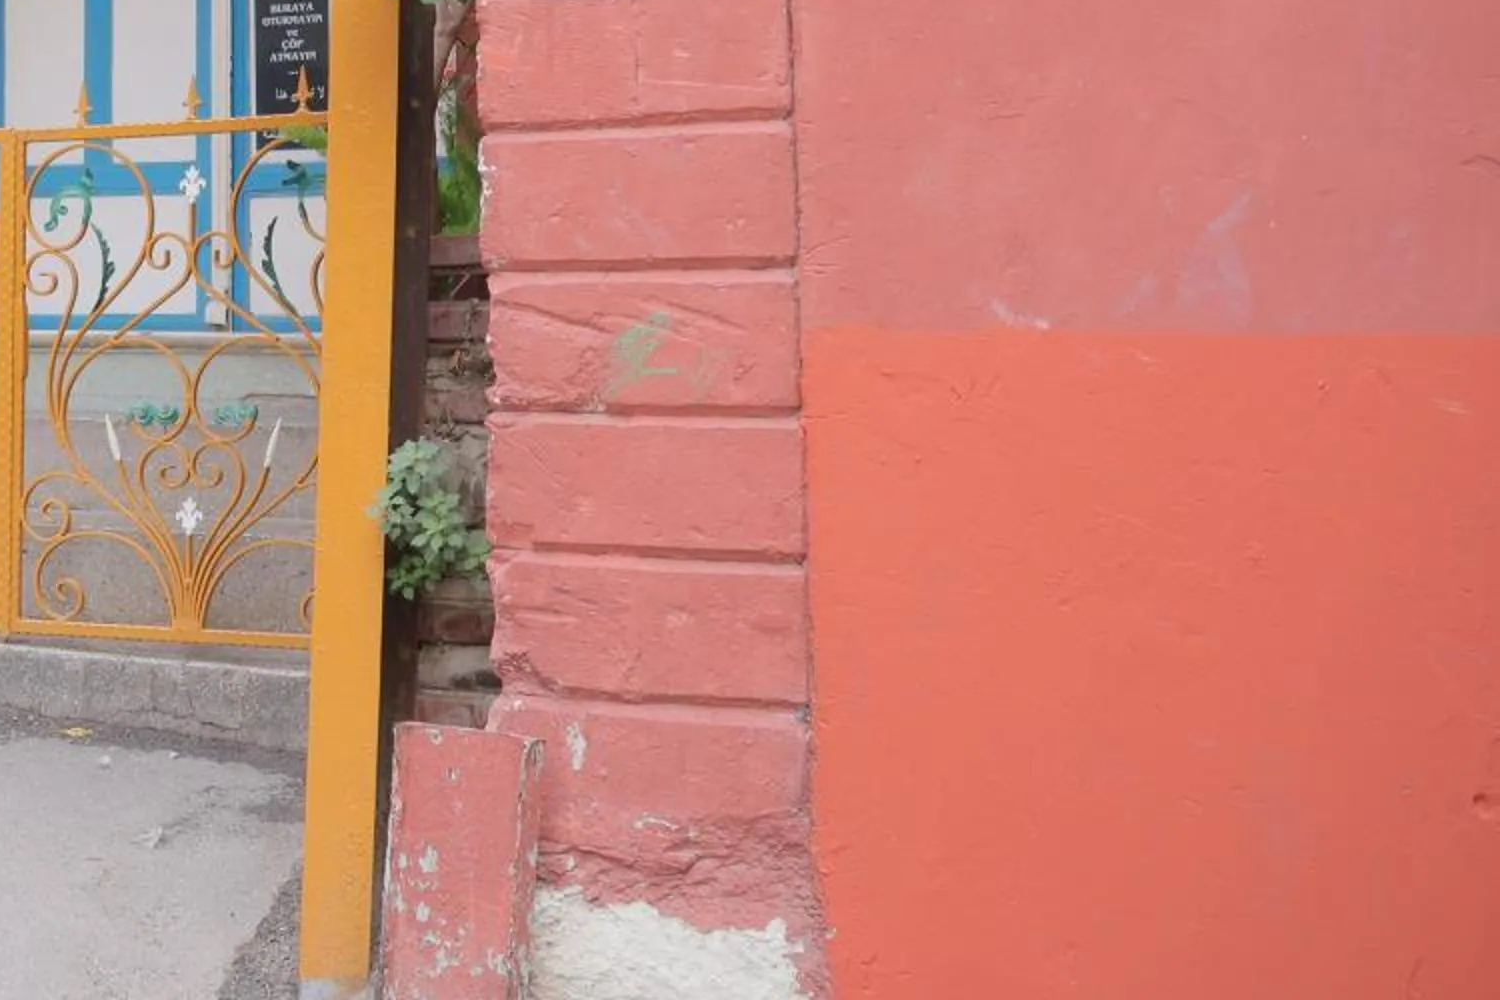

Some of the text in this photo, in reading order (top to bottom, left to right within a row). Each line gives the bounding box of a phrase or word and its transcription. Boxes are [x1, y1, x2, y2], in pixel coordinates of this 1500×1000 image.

[269, 2, 314, 14] BURAYA
[261, 13, 323, 27] OTURMAYIN
[269, 51, 317, 62] ATMAYIN
